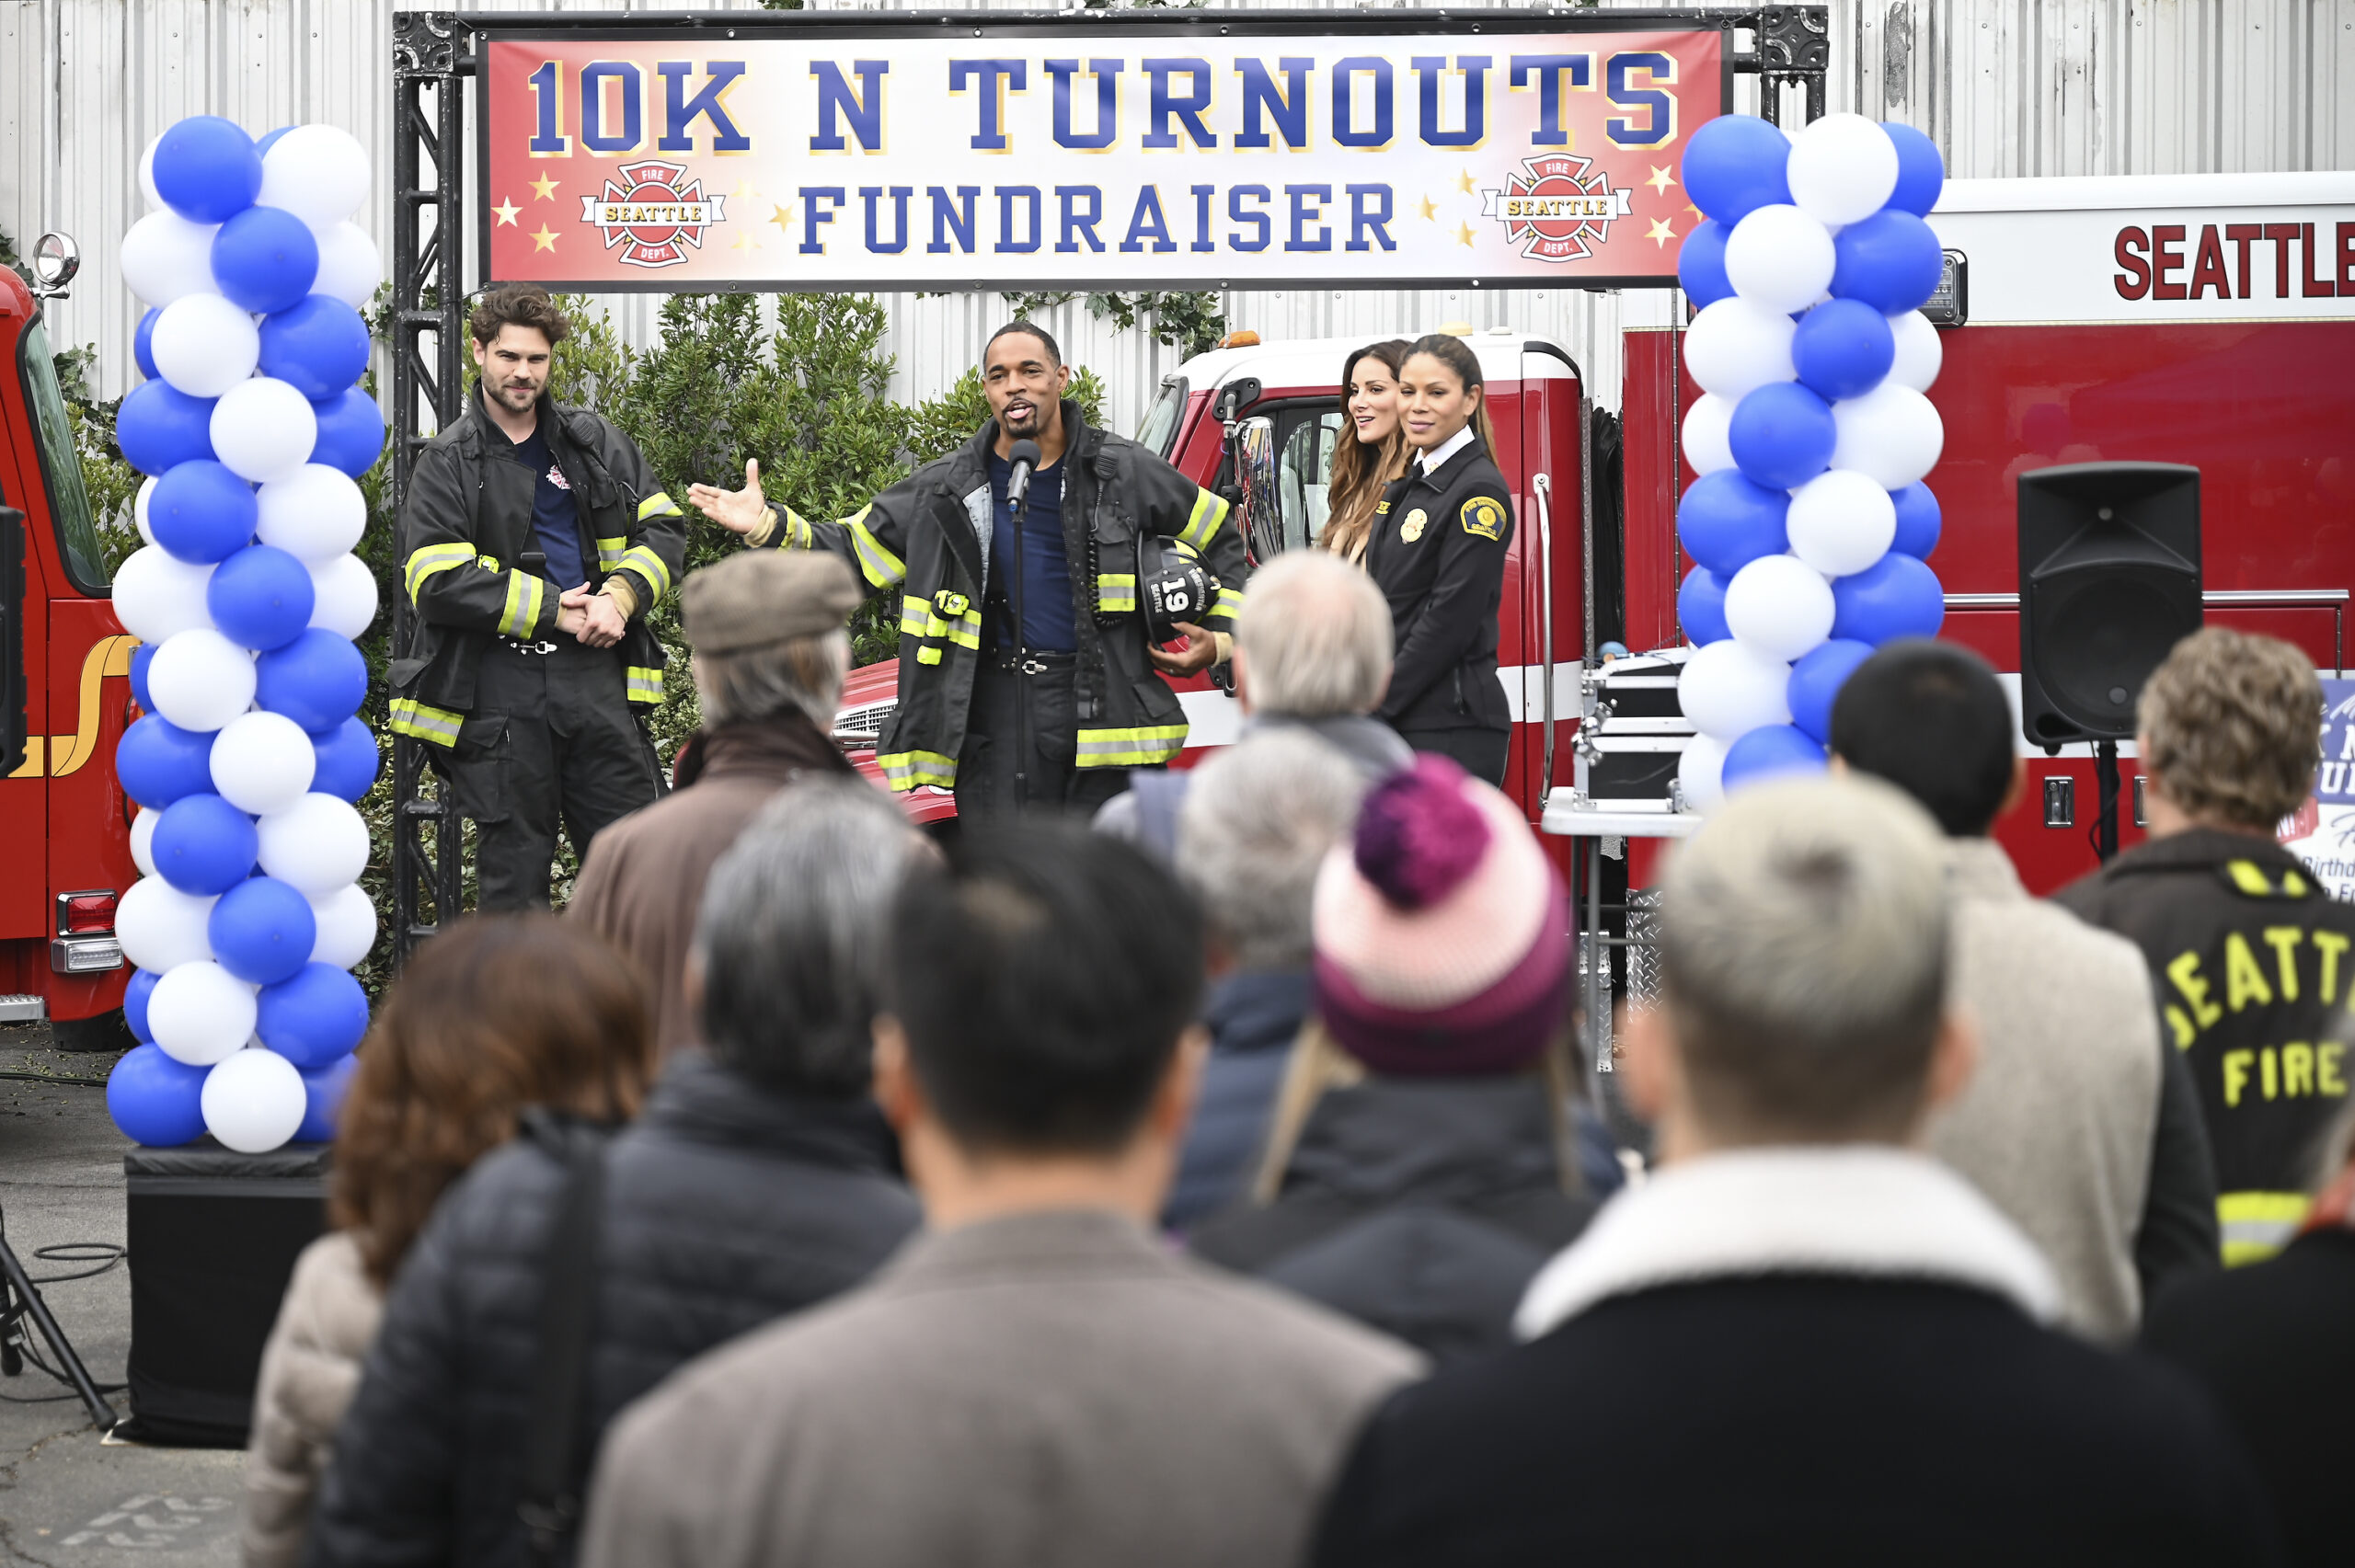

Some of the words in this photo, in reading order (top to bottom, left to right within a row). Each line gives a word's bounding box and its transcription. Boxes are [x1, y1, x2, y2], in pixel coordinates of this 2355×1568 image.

[528, 58, 754, 157] 10K
[809, 58, 890, 155] N
[948, 52, 1678, 155] TURNOUTS
[641, 169, 664, 180] FIRE
[1545, 163, 1569, 174] FIRE
[604, 206, 702, 223] SEATTLE
[798, 182, 1397, 256] FUNDRAISER
[1507, 200, 1608, 216] SEATTLE
[640, 247, 670, 259] DEPT.
[1543, 242, 1573, 254] DEPT.
[1151, 583, 1163, 613] SEATTLE
[1162, 577, 1189, 612] 19
[2165, 925, 2355, 1052] EATT
[2222, 1041, 2349, 1107] FIRE
